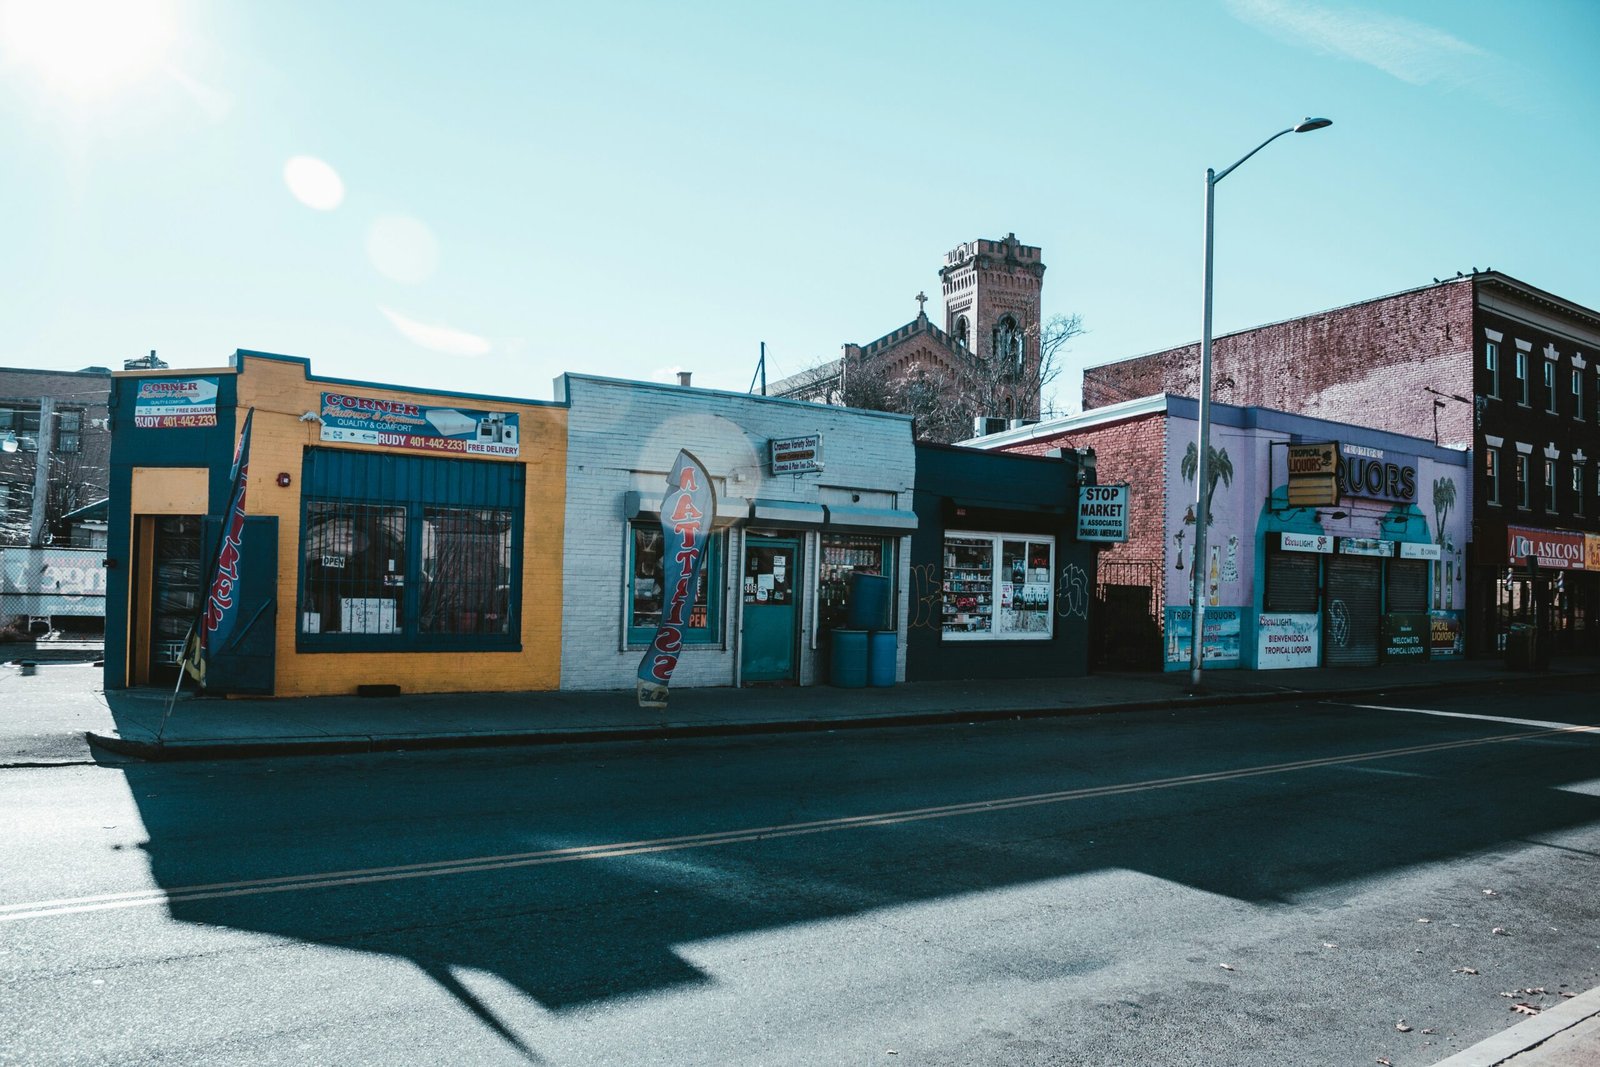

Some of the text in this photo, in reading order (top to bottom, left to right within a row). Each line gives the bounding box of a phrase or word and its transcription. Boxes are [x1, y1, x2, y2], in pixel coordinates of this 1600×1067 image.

[142, 382, 198, 392] CORNER
[325, 394, 419, 416] CORNER
[135, 415, 217, 427] RUDY 401-442-2331
[337, 418, 368, 428] QUALITY
[376, 423, 412, 432] COMFORT
[378, 433, 405, 446] RUDY
[409, 436, 466, 451] 401-442-2331
[467, 443, 518, 455] FREE DELIVERY
[1290, 448, 1322, 458] TROPICAL
[1289, 458, 1321, 472] LIQUORS
[1338, 455, 1416, 500] QUORS
[1086, 488, 1119, 501] STOP
[1081, 504, 1122, 517] MARKET
[1087, 519, 1122, 527] ASSOCIATES
[1099, 529, 1122, 538] AMERICAN
[1299, 539, 1314, 548] LIGHT
[1521, 540, 1579, 560] CLASICOS
[323, 556, 344, 567] OPEN
[689, 614, 707, 628] PEN
[1207, 610, 1236, 621] LIQUORS
[1276, 618, 1292, 627] LIGHT
[1268, 634, 1304, 643] BIENVENIDOS
[1392, 636, 1413, 645] WELCOME
[1431, 631, 1455, 641] LIQUORS
[1265, 645, 1312, 656] TROPICAL LIQUOR
[1387, 646, 1424, 656] TROPICAL LIQUOR
